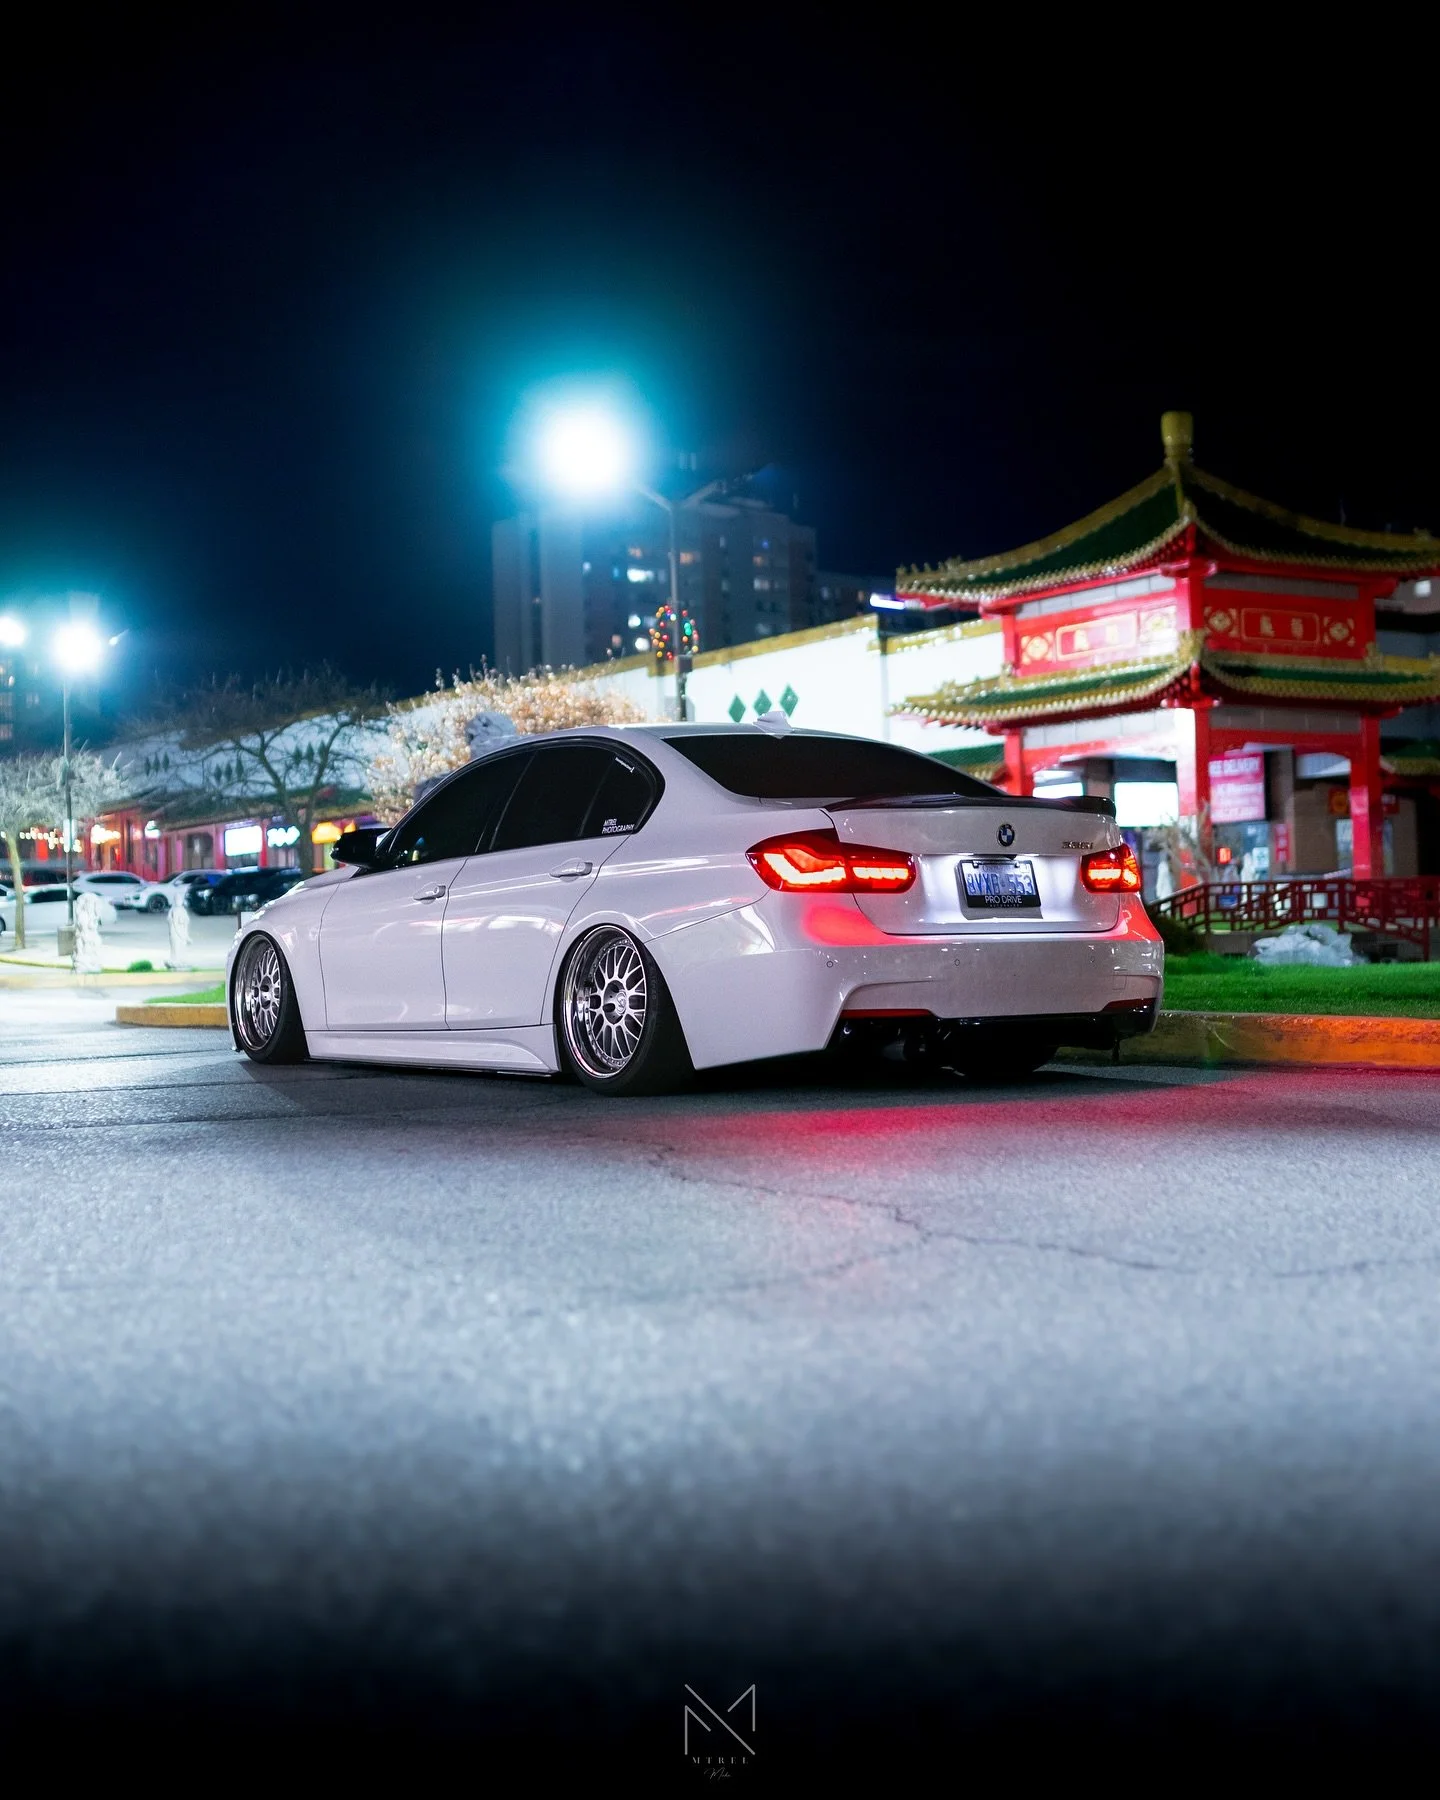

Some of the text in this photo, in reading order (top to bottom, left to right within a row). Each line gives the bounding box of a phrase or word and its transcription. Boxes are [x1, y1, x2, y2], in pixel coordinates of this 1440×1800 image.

[601, 824, 635, 834] PHOTOGRAPHY
[985, 895, 1023, 904] PRO DRIVE
